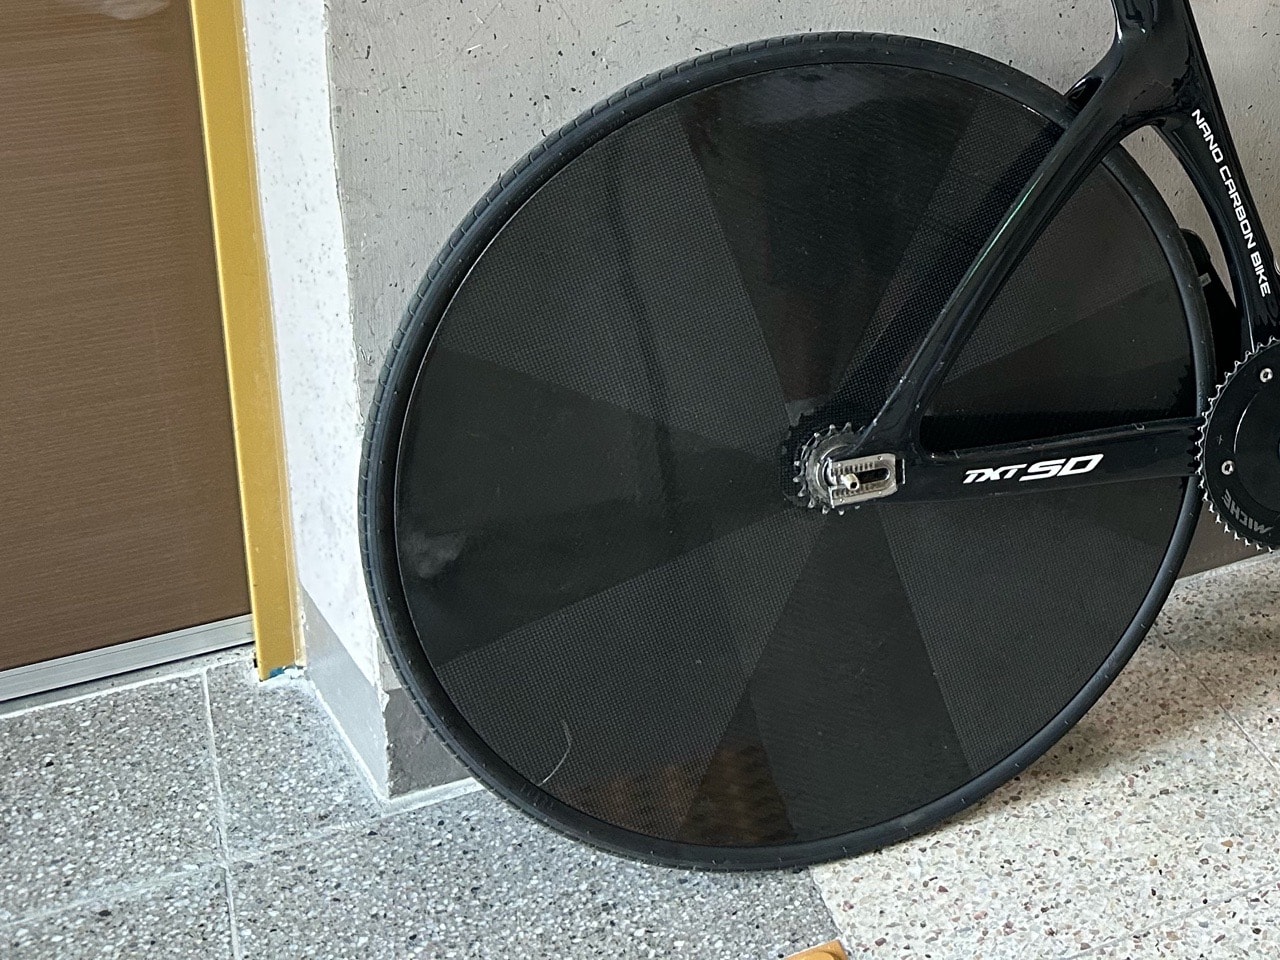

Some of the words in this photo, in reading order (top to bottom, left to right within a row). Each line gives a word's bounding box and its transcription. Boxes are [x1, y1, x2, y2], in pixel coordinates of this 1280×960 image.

[1191, 108, 1224, 164] NANO
[1218, 165, 1257, 250] CARBON
[1250, 250, 1271, 298] BIKE
[962, 463, 1028, 484] TXT
[1018, 453, 1104, 482] SD
[1220, 488, 1276, 535] MICHE
